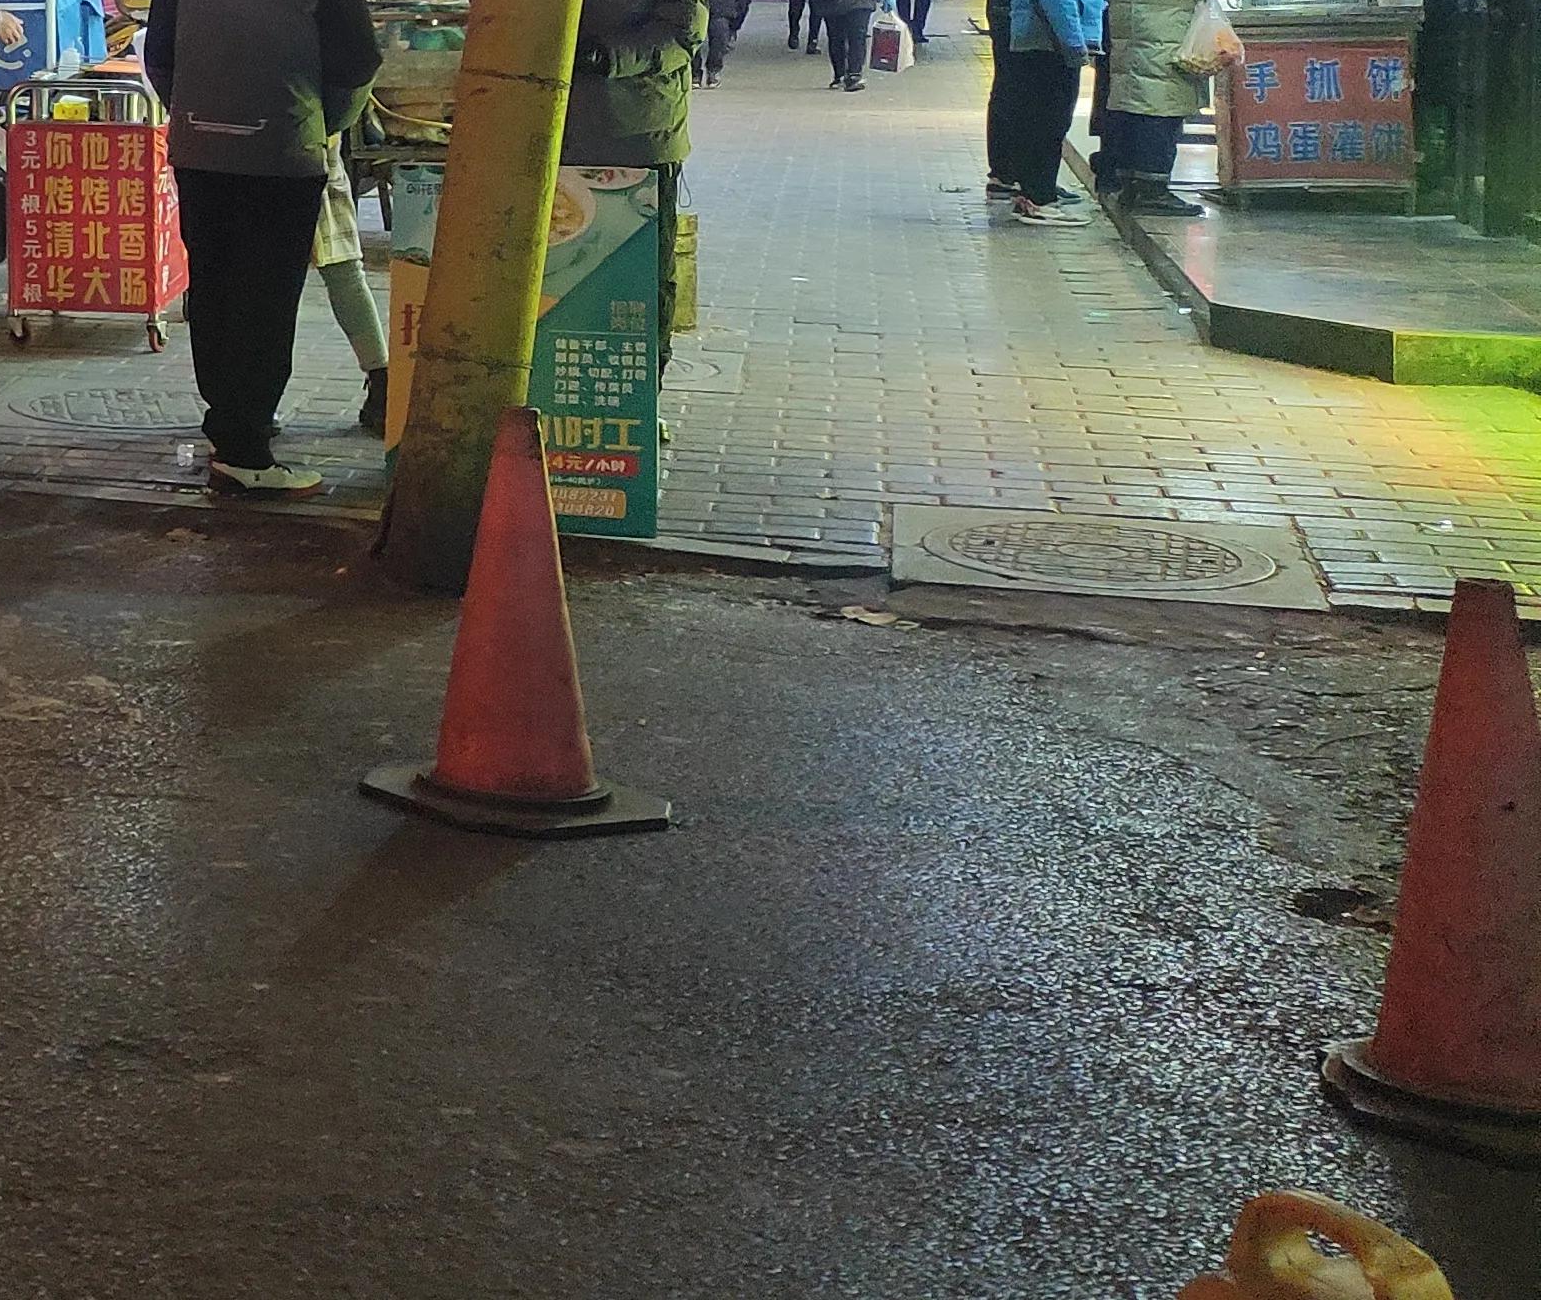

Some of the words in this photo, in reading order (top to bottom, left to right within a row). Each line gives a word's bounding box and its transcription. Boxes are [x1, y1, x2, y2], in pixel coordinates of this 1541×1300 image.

[1244, 55, 1403, 102] 手抓饼
[1245, 121, 1406, 163] 鸡蛋灌饼
[45, 132, 74, 302] 你烤清华
[81, 132, 111, 305] 他烤北大
[117, 133, 147, 306] 我烤香肠
